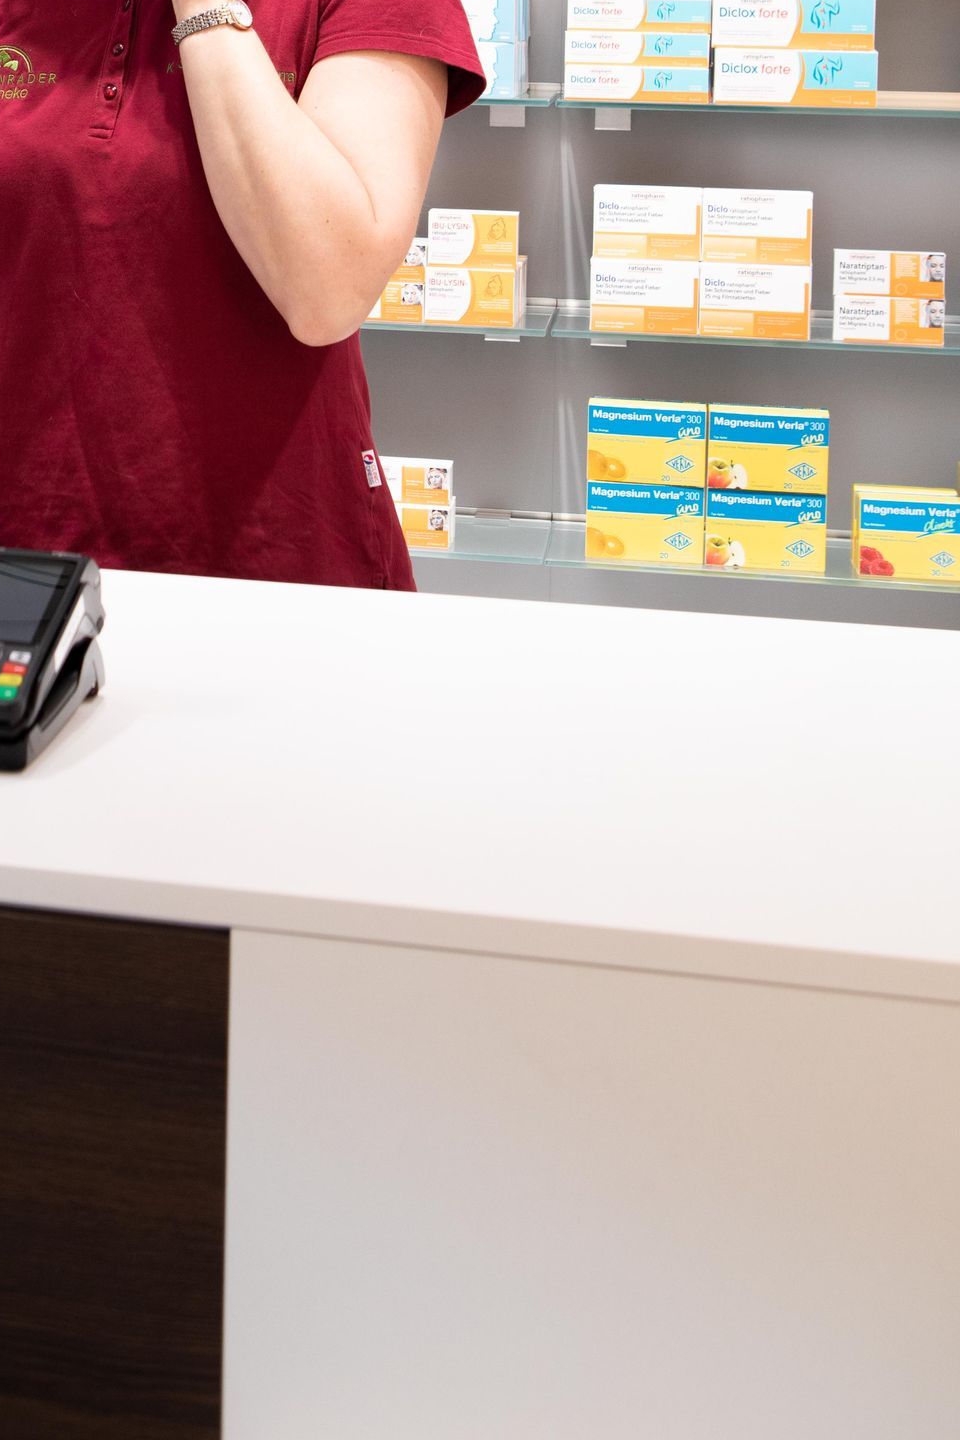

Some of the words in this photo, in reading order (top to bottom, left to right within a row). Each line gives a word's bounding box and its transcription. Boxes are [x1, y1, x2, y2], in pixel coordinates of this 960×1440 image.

[573, 7, 599, 15] Diclox
[601, 7, 622, 15] forte
[719, 7, 755, 18] Diclox
[758, 7, 788, 19] forte
[571, 41, 597, 49] Diclox
[599, 41, 620, 49] forte
[721, 63, 758, 74] Diclox
[761, 63, 790, 75] forte
[570, 75, 596, 83] Diclox
[598, 76, 619, 84] forte
[708, 205, 728, 213] Diclo
[596, 274, 616, 282] Diclo
[593, 409, 652, 421] Magnesium
[687, 415, 701, 424] 300
[714, 417, 774, 428] Magnesium
[810, 423, 825, 431] 300
[591, 487, 651, 499] Magnesium
[685, 492, 700, 501] 300
[711, 493, 771, 506] Magnesium
[807, 499, 822, 508] 300
[863, 504, 925, 516] Magnesium
